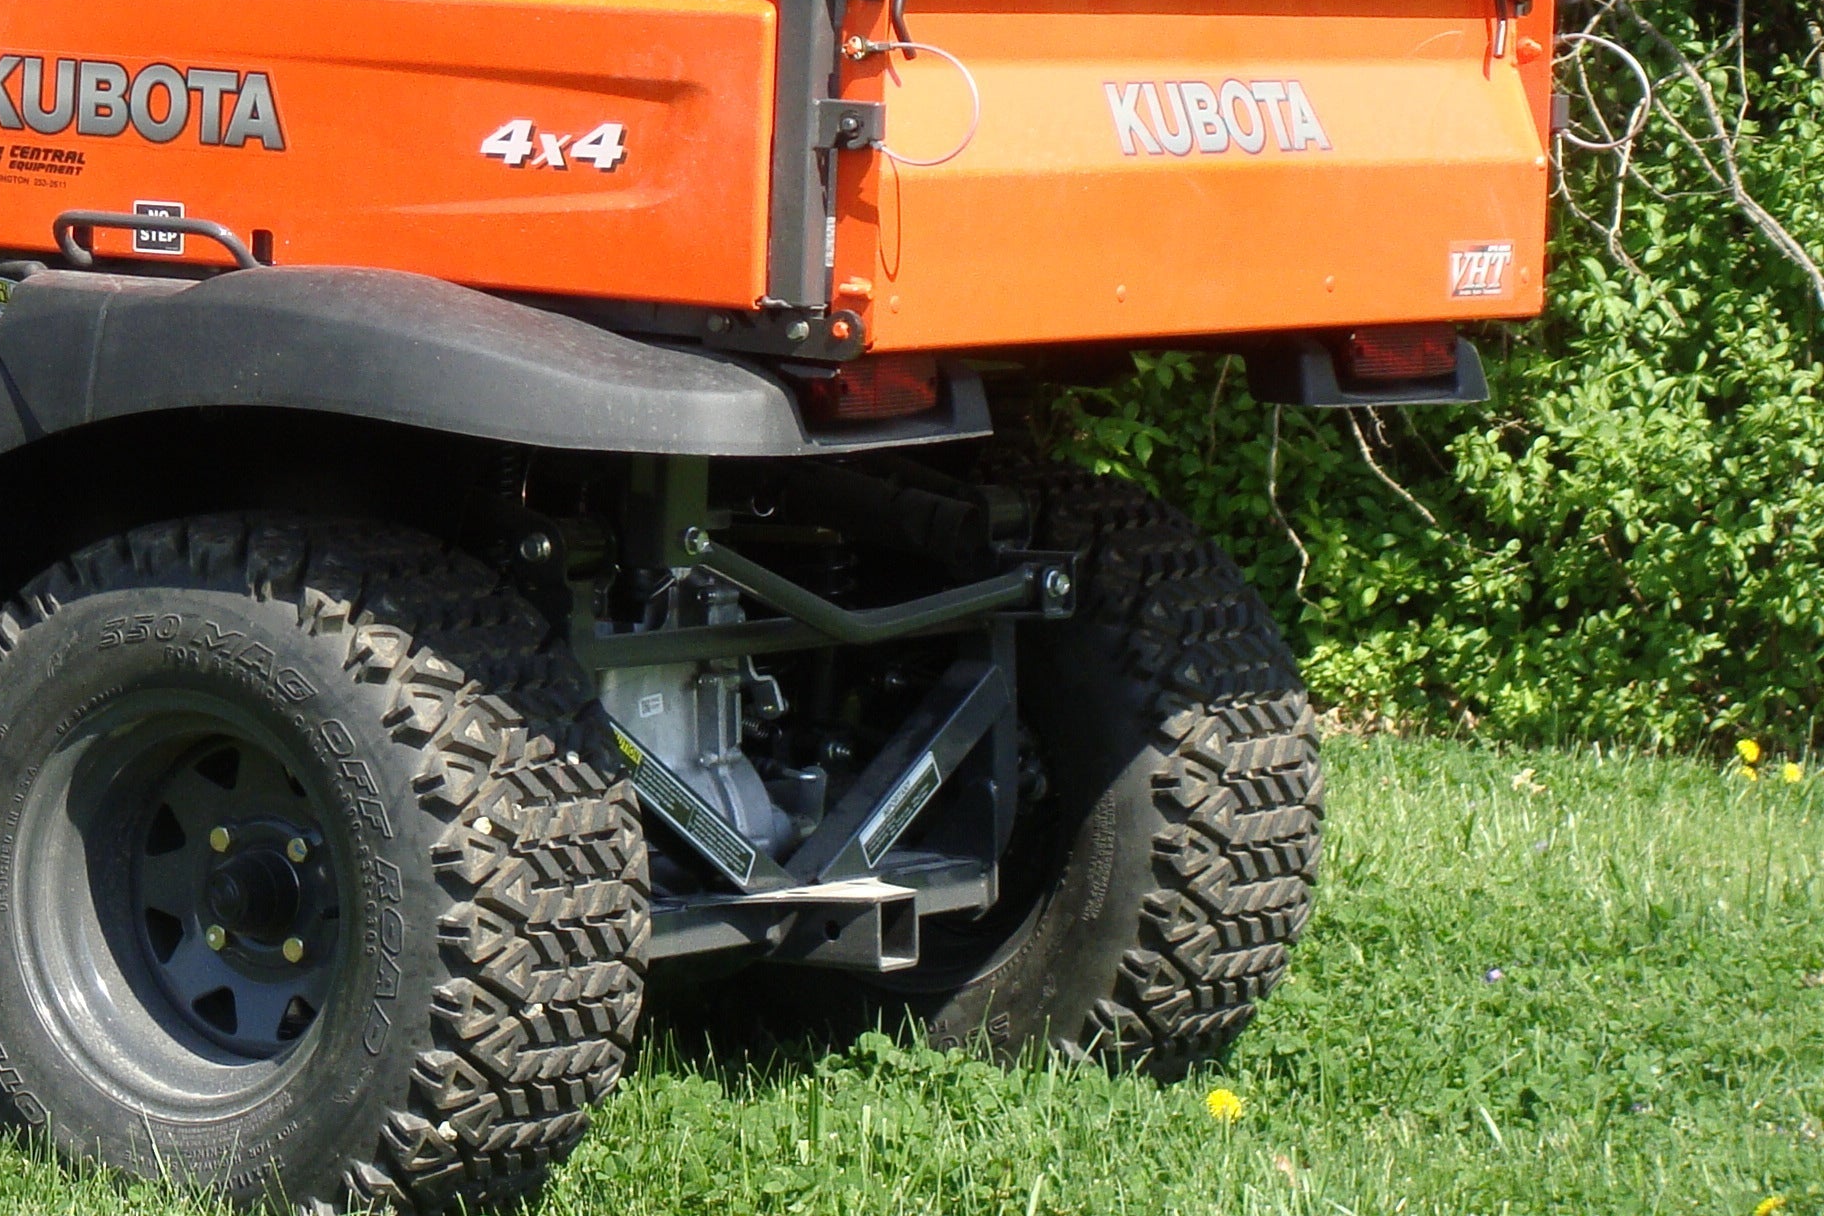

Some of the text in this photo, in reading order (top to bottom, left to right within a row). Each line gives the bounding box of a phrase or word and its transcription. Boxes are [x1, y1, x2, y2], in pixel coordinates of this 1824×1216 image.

[1103, 78, 1333, 157] KUBOTA
[8, 160, 83, 176] EQUIPMENT
[9, 145, 86, 165] CENTRAL
[480, 119, 628, 173] 4x4
[1451, 251, 1513, 294] VHT
[191, 620, 316, 701] MAG
[318, 719, 392, 840] OFF
[366, 856, 406, 1057] ROAD
